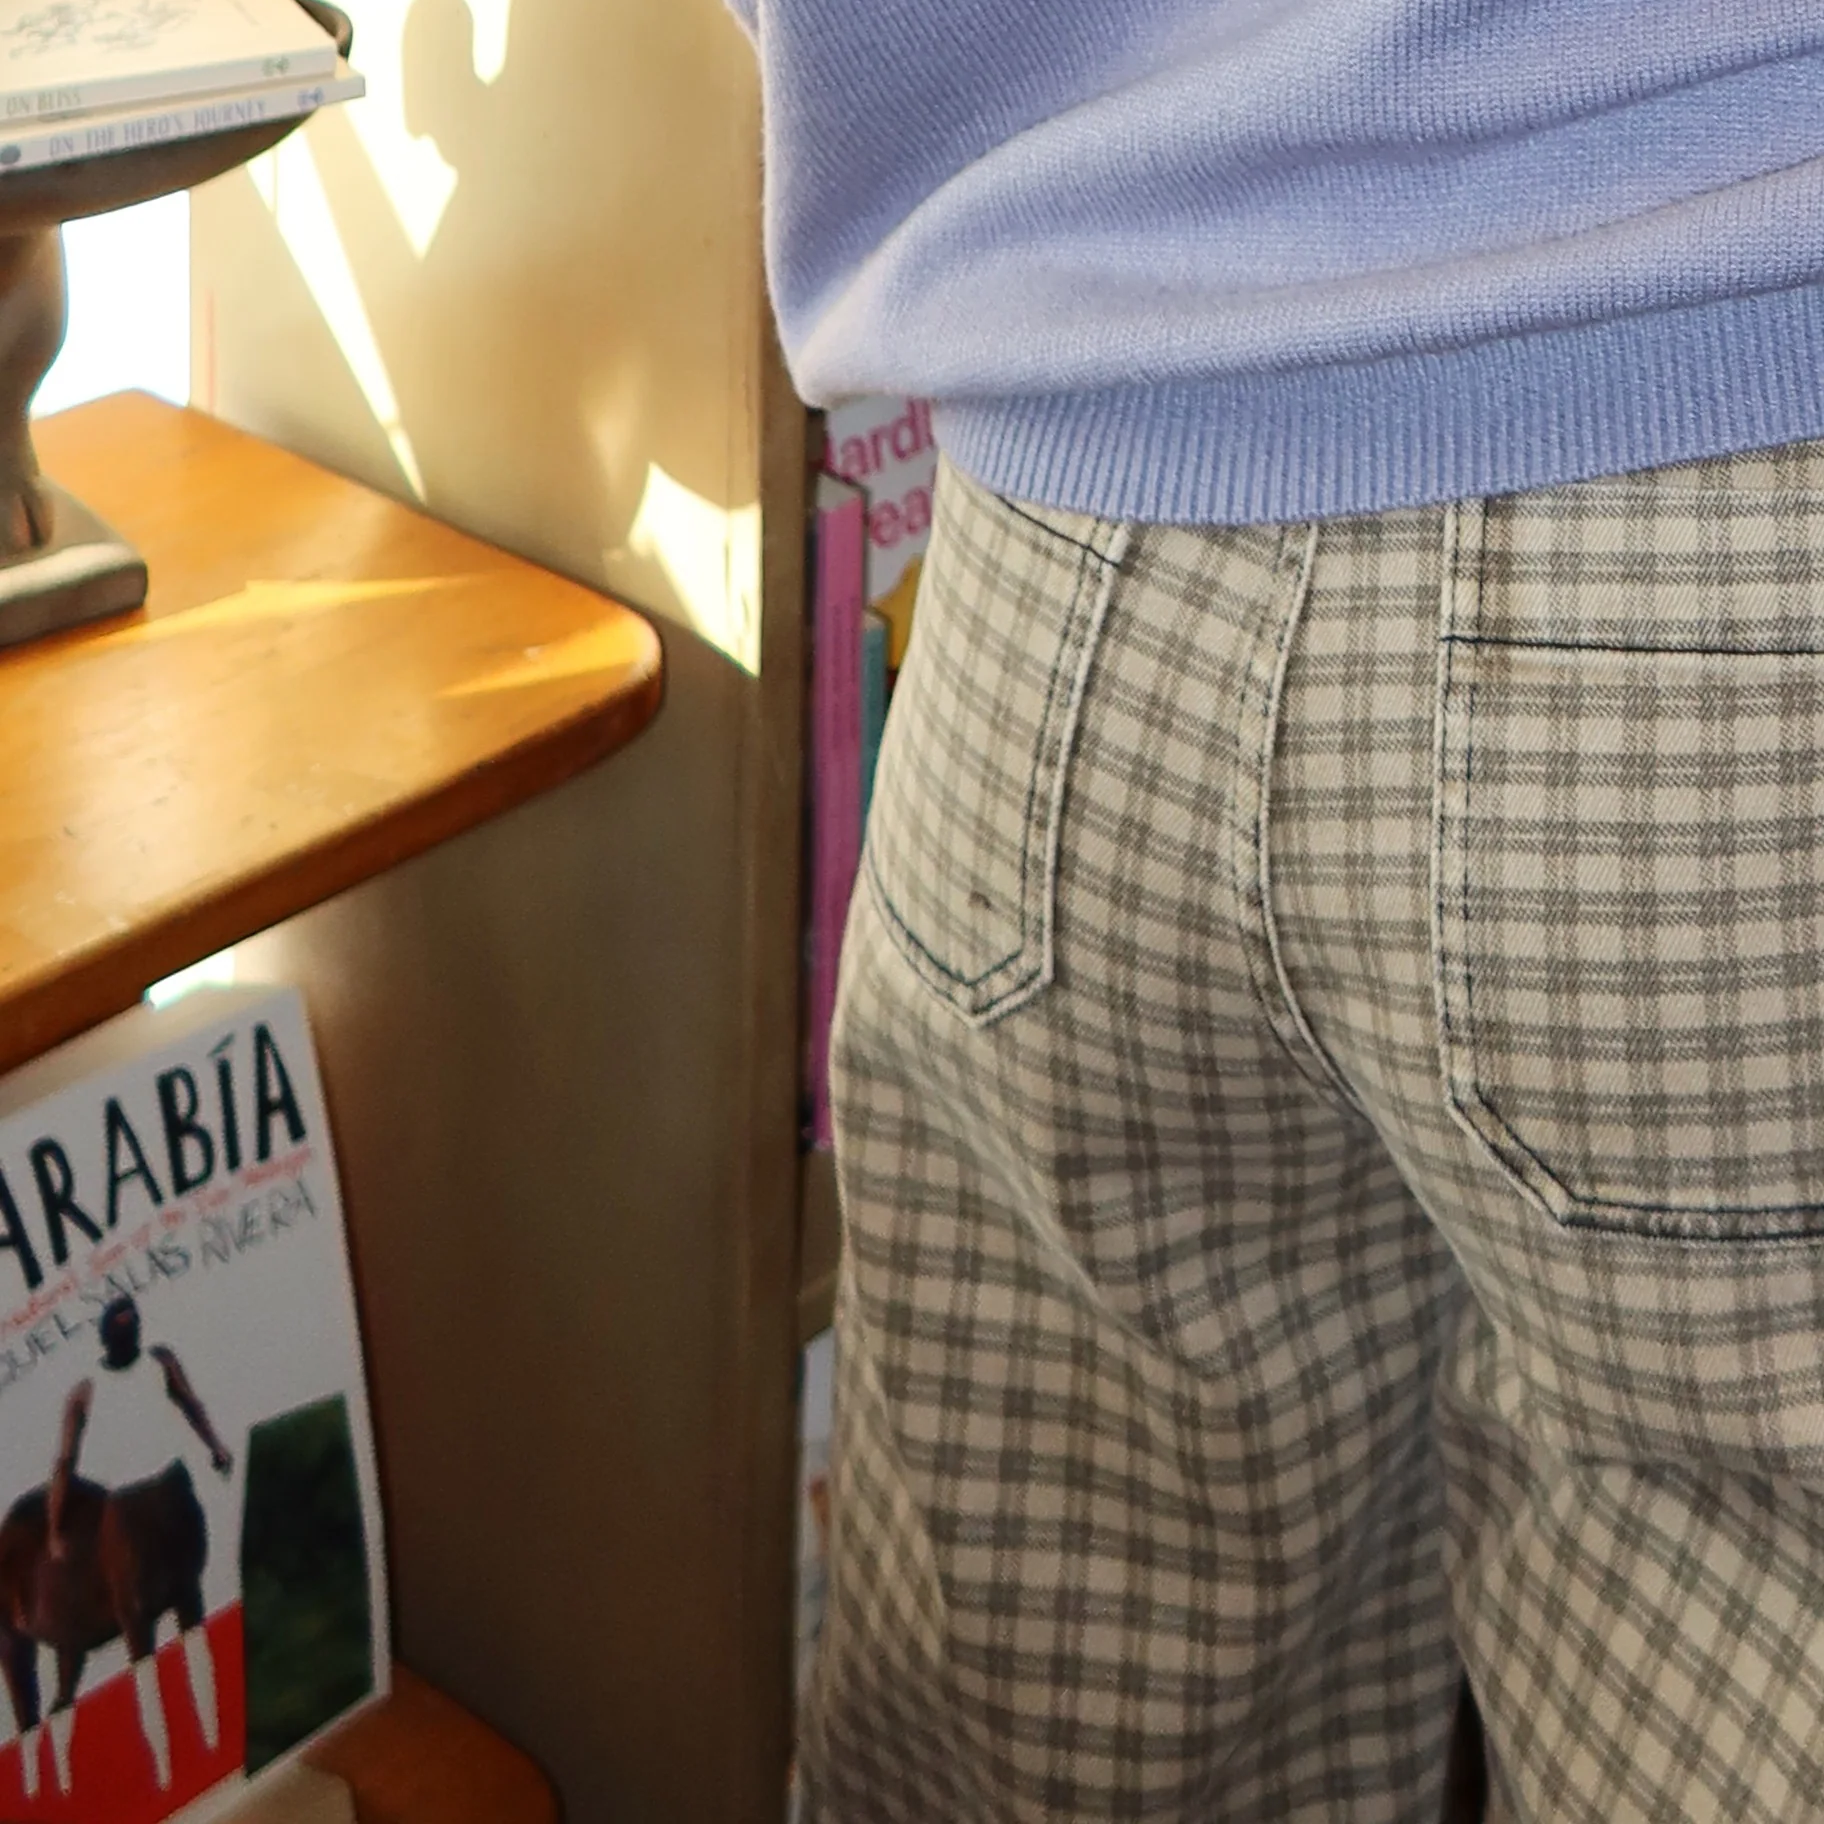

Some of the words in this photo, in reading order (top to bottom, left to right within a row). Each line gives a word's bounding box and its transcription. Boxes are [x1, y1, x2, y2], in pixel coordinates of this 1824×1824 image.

[5, 95, 31, 116] ON
[36, 87, 81, 109] BLISS
[48, 136, 75, 156] ON
[85, 127, 118, 150] THE
[122, 114, 184, 140] HERO'S
[192, 98, 269, 130] JOURNEY
[200, 1178, 320, 1266] RIVERA
